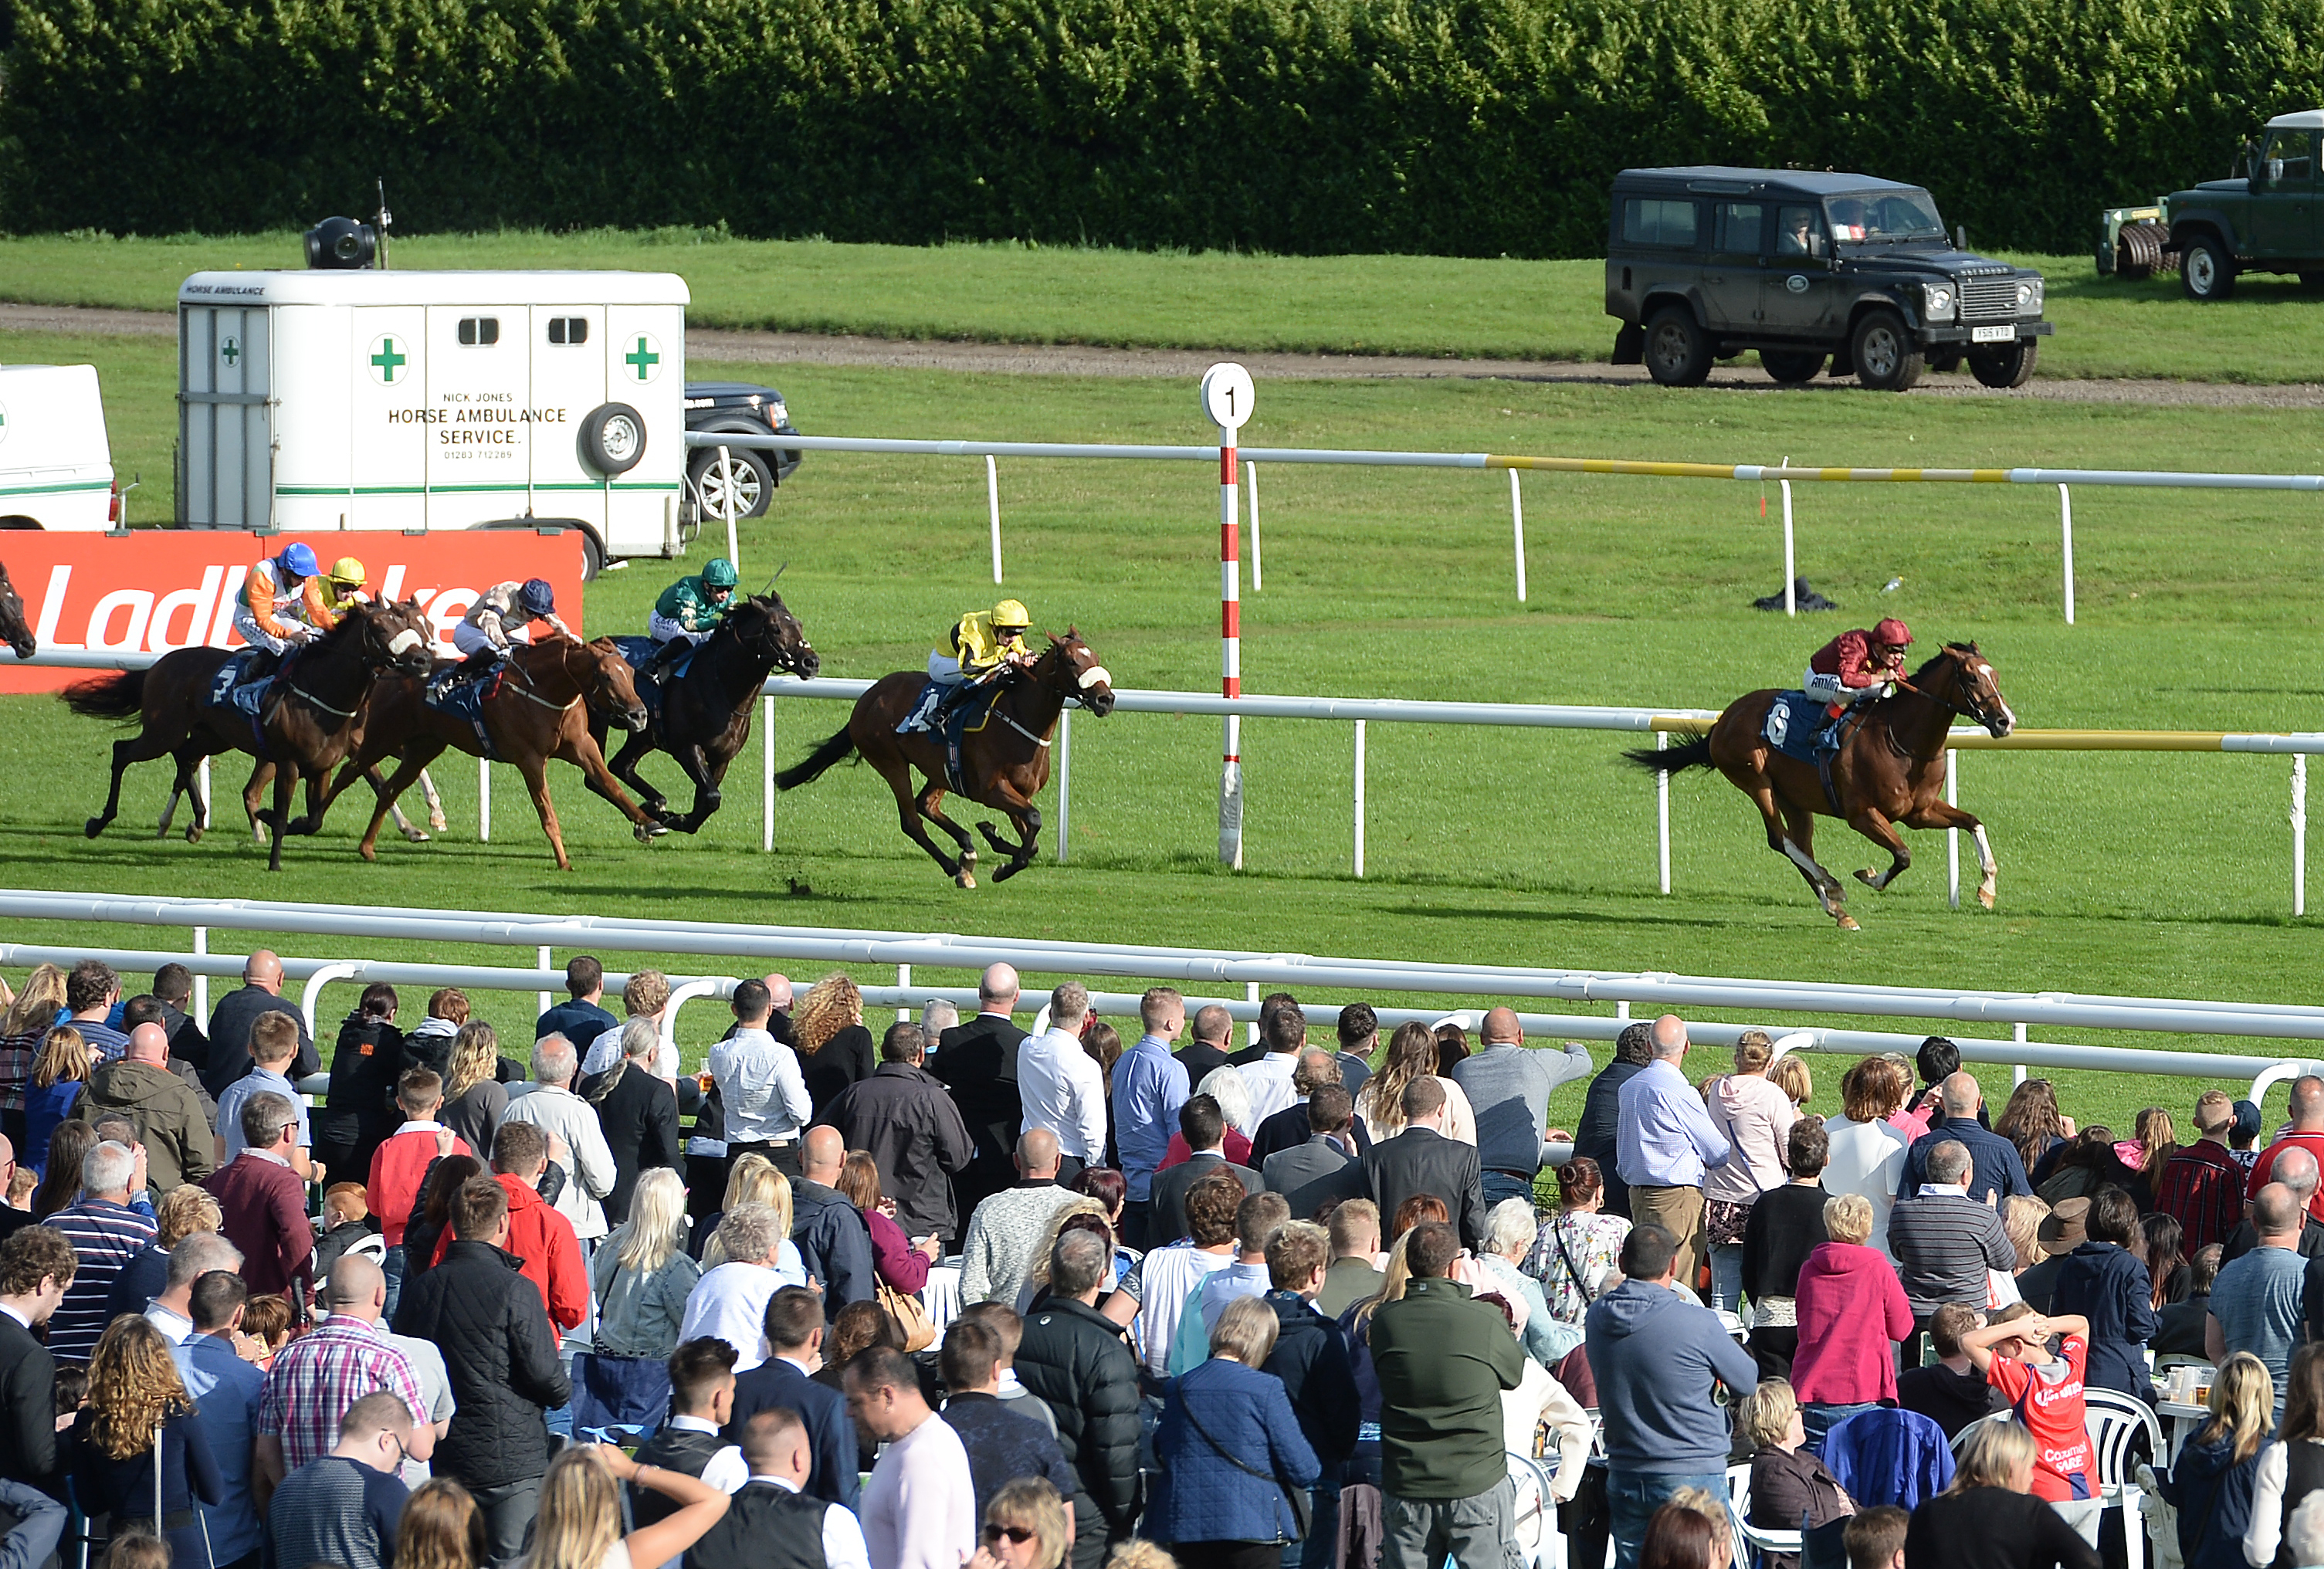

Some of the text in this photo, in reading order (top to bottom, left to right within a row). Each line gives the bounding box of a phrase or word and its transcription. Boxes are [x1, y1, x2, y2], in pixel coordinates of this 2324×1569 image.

[215, 286, 266, 295] AMBULANCE
[443, 393, 513, 402] NICK JONES
[1225, 386, 1235, 417] 1
[388, 408, 567, 423] HORSE AMBULANCE
[440, 430, 521, 444] SERVICE.
[444, 451, 473, 459] 01283
[1767, 703, 1790, 745] 6
